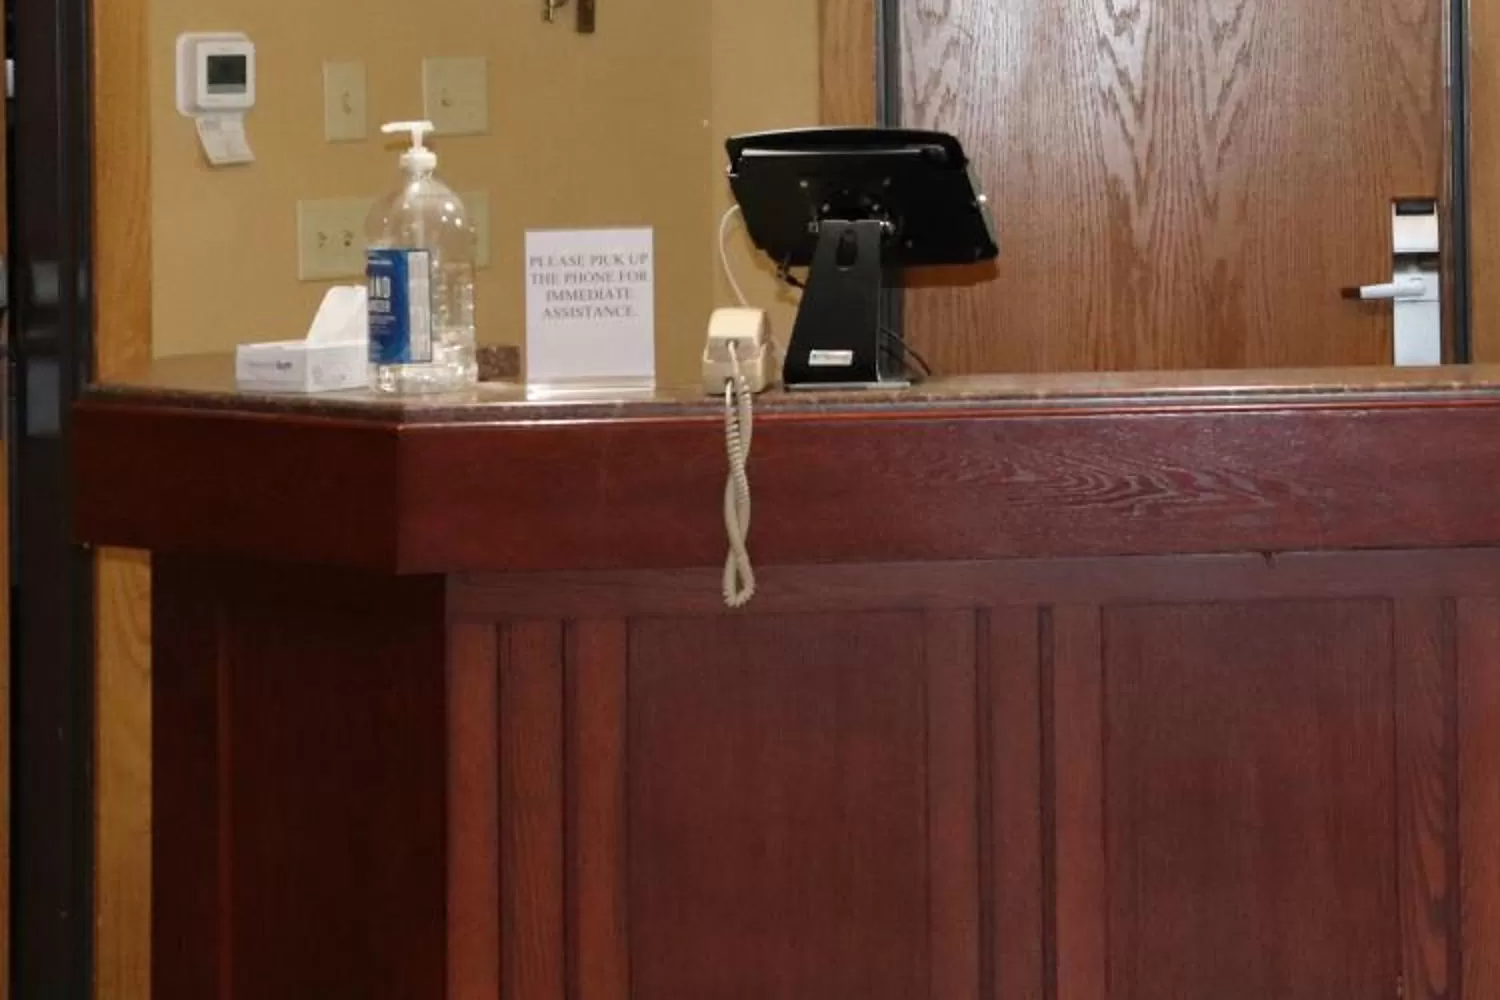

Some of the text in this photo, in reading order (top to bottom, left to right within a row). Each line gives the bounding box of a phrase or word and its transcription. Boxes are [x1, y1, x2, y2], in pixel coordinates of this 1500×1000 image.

[529, 252, 649, 268] PLEASE PICK UP
[530, 270, 648, 285] THE PHONE FOR
[545, 288, 633, 302] IMMEDIATE
